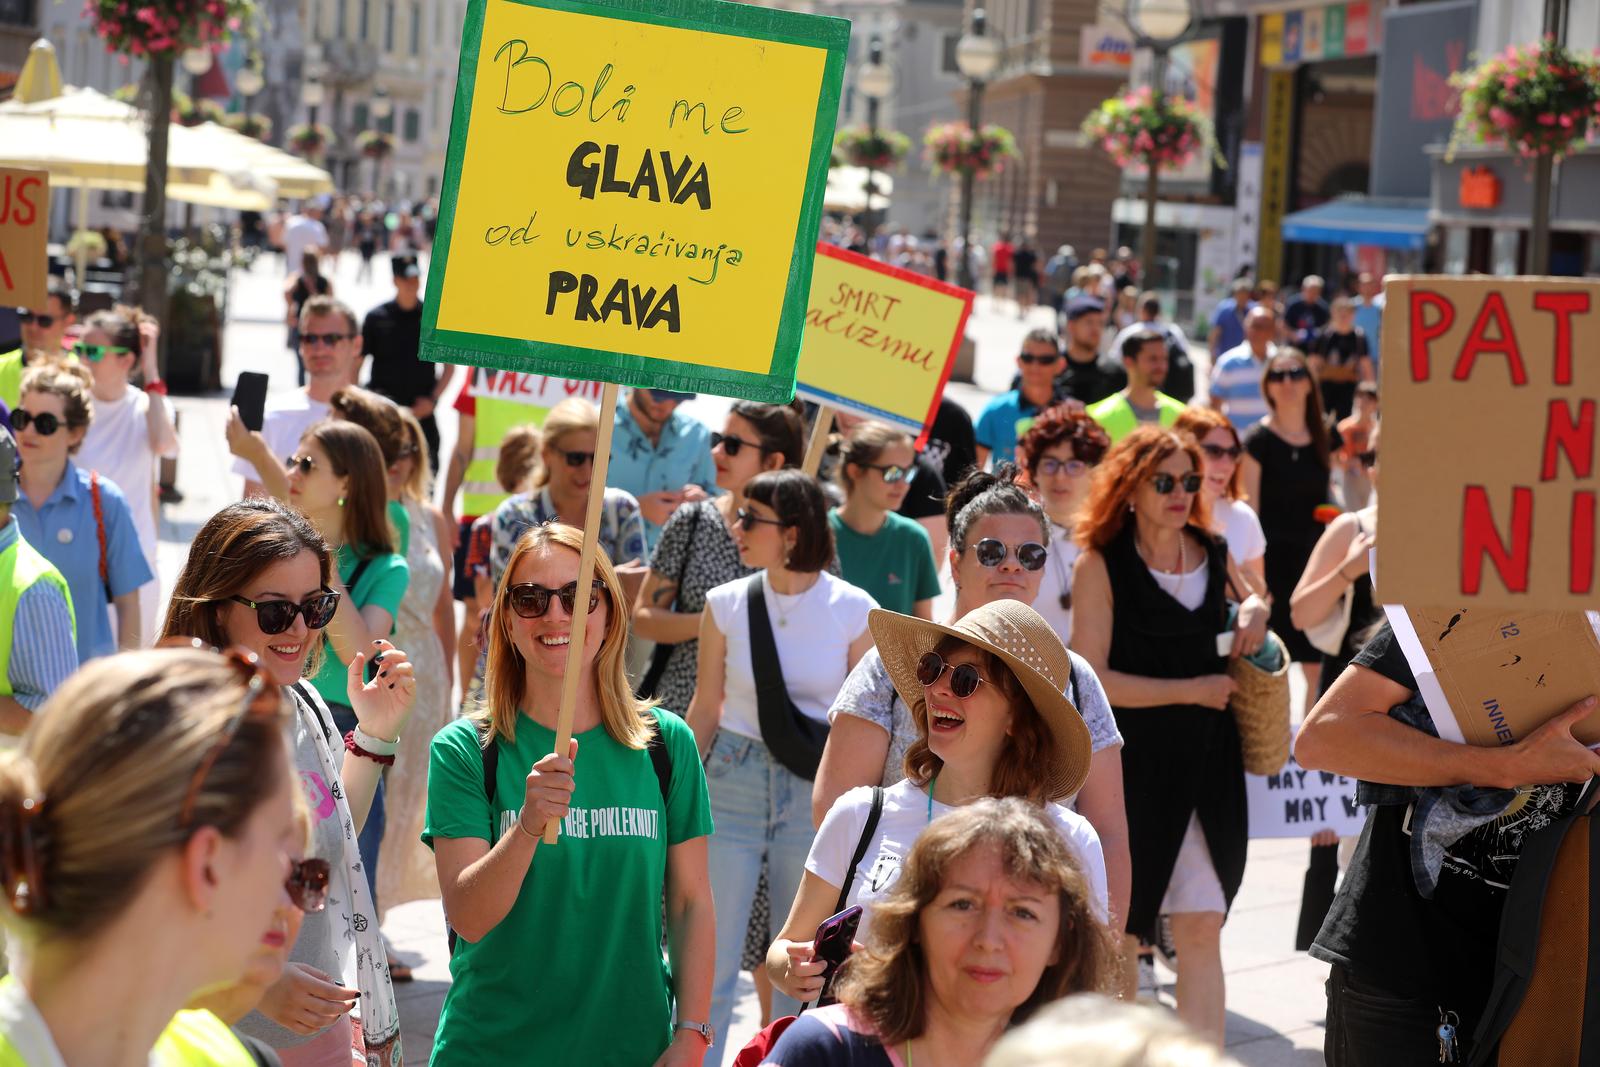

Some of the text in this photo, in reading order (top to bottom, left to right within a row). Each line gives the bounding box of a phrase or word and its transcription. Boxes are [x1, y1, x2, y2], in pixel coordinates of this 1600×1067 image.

[494, 39, 750, 135] Boli me
[566, 141, 712, 210] GLAVA
[485, 211, 541, 246] od
[545, 270, 681, 333] PRAVA
[830, 283, 902, 321] SMRT
[1409, 289, 1591, 387] PAT
[1500, 621, 1521, 639] 12
[1267, 769, 1307, 790] MAY
[591, 807, 659, 840] POKLEKNUTI
[1285, 796, 1328, 823] MAY
